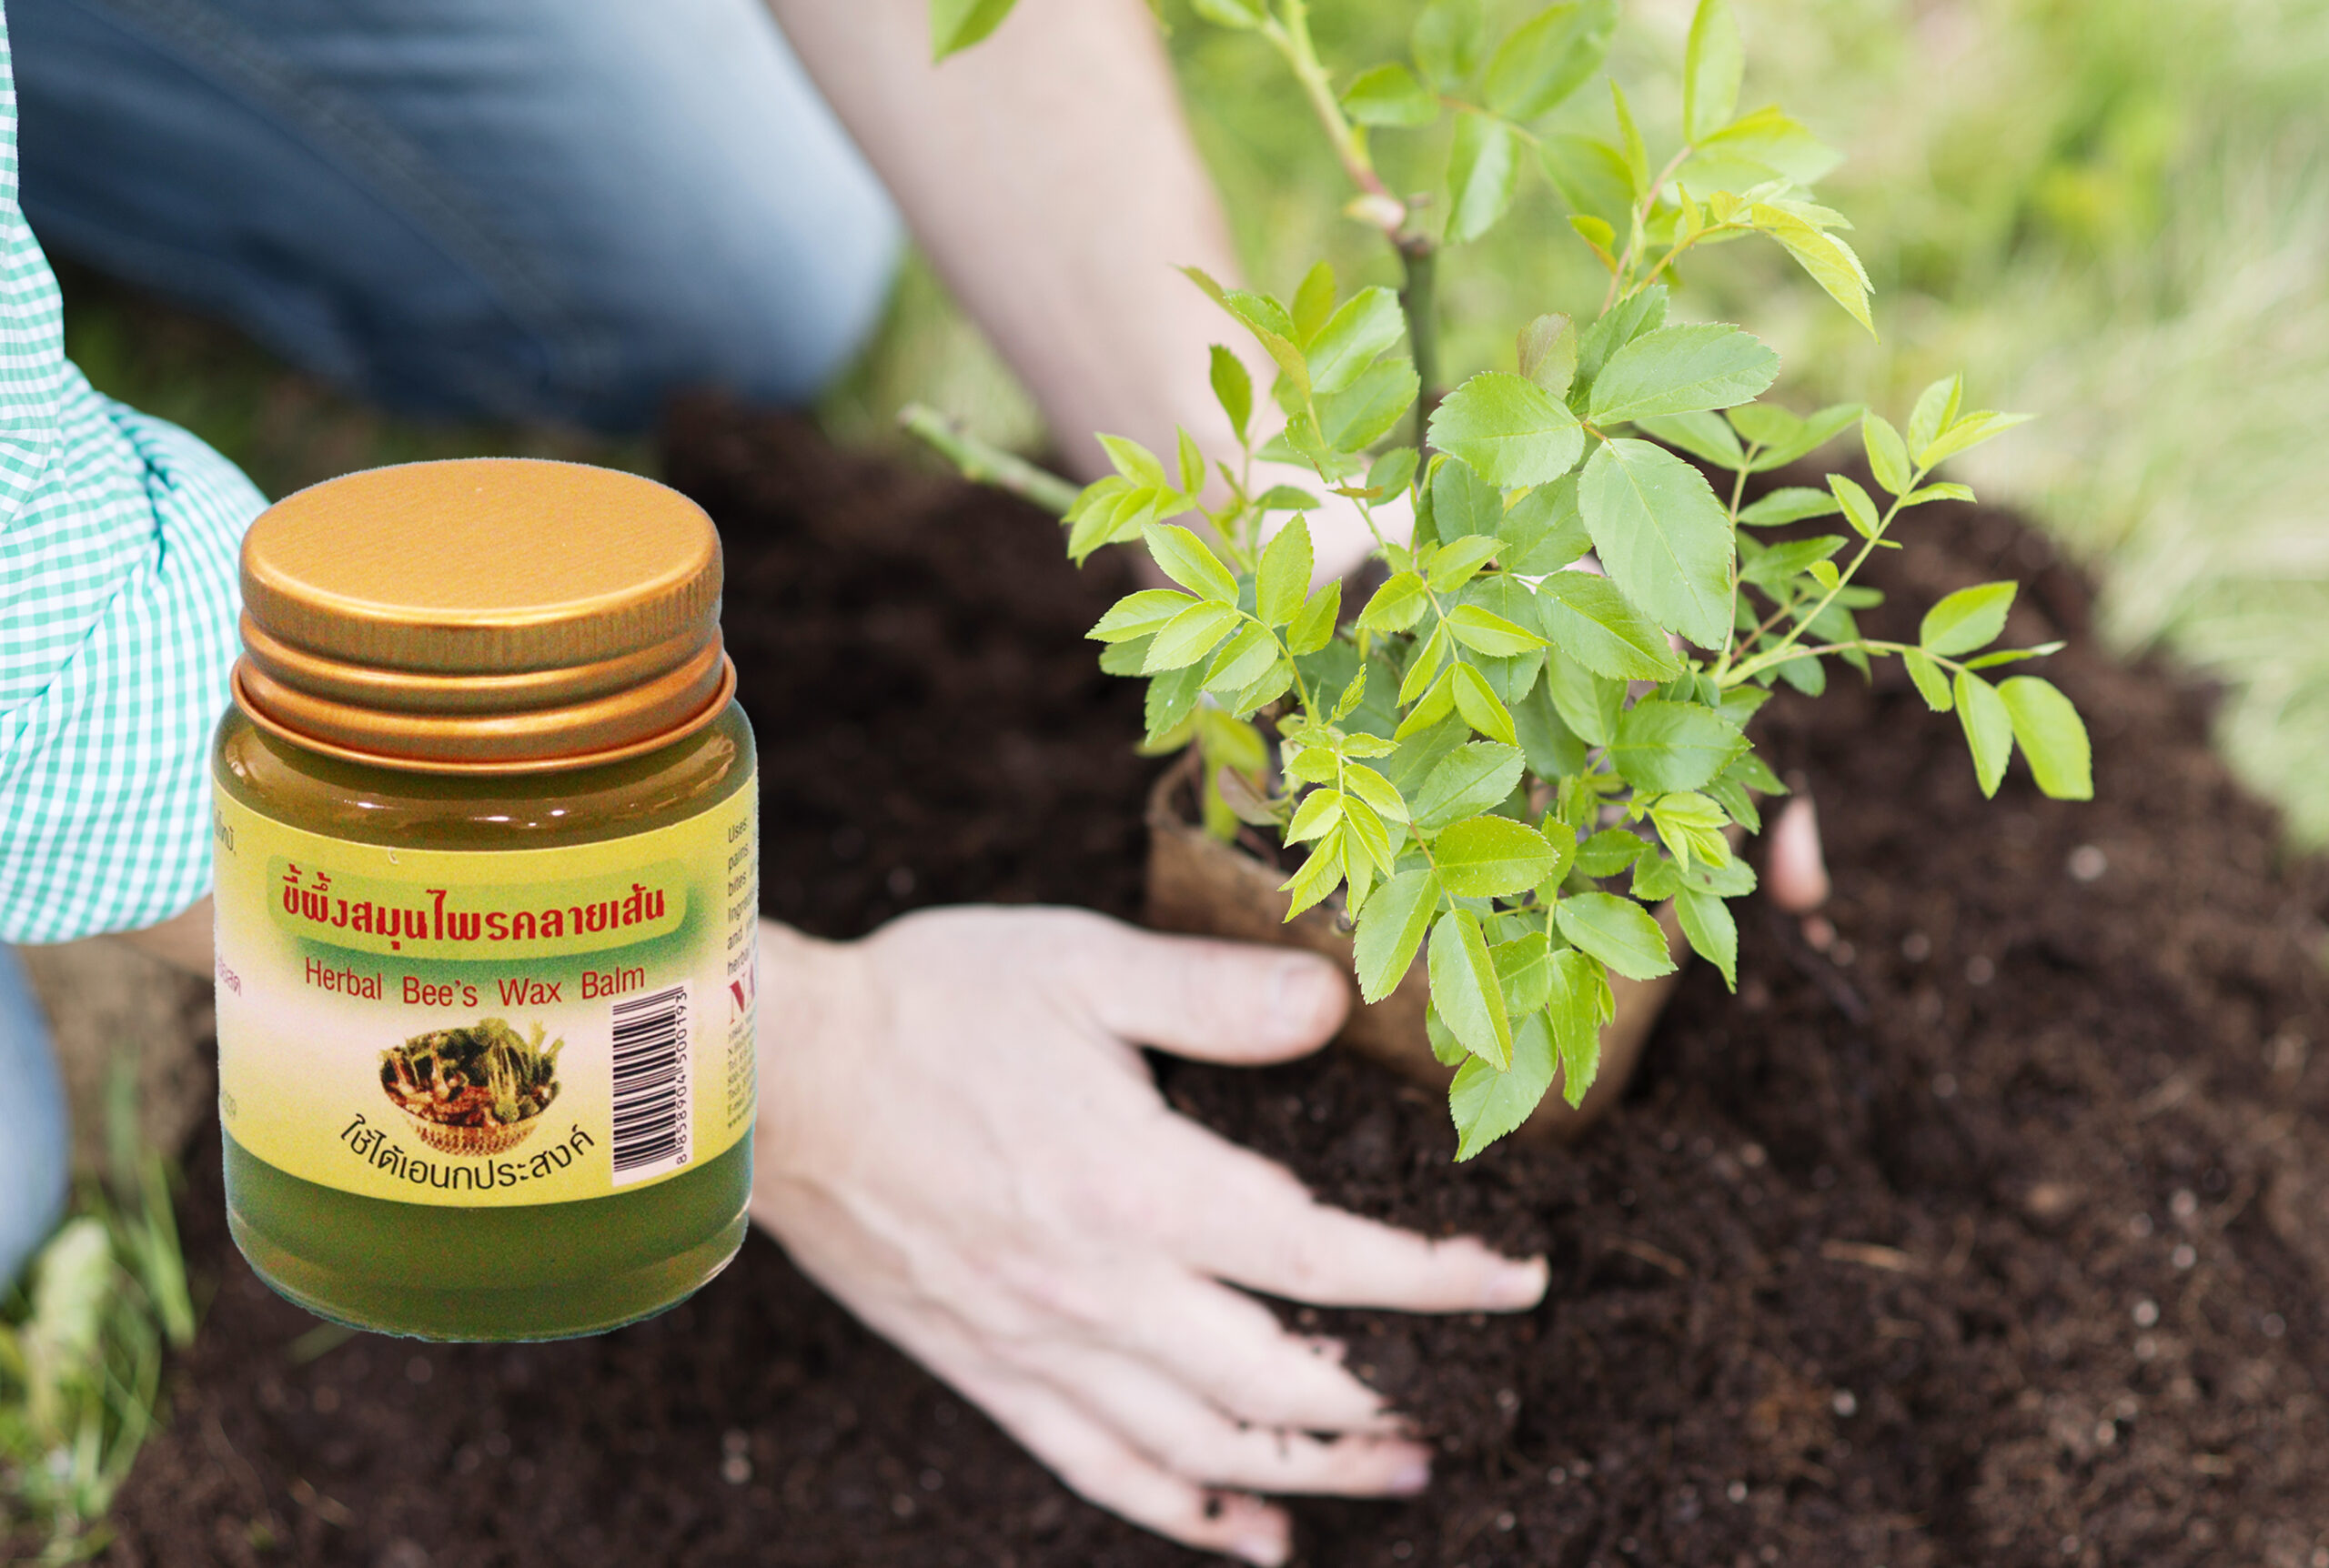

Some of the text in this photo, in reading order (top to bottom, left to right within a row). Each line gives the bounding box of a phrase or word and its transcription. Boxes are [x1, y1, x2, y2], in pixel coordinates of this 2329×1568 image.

[282, 863, 665, 950] ขี้ผึ้งสมุนไพรคลายเส้น
[305, 956, 645, 1007] Herbal Bee's Wax Balm
[340, 1112, 596, 1191] ใช้ได้เอนกประสงค์
